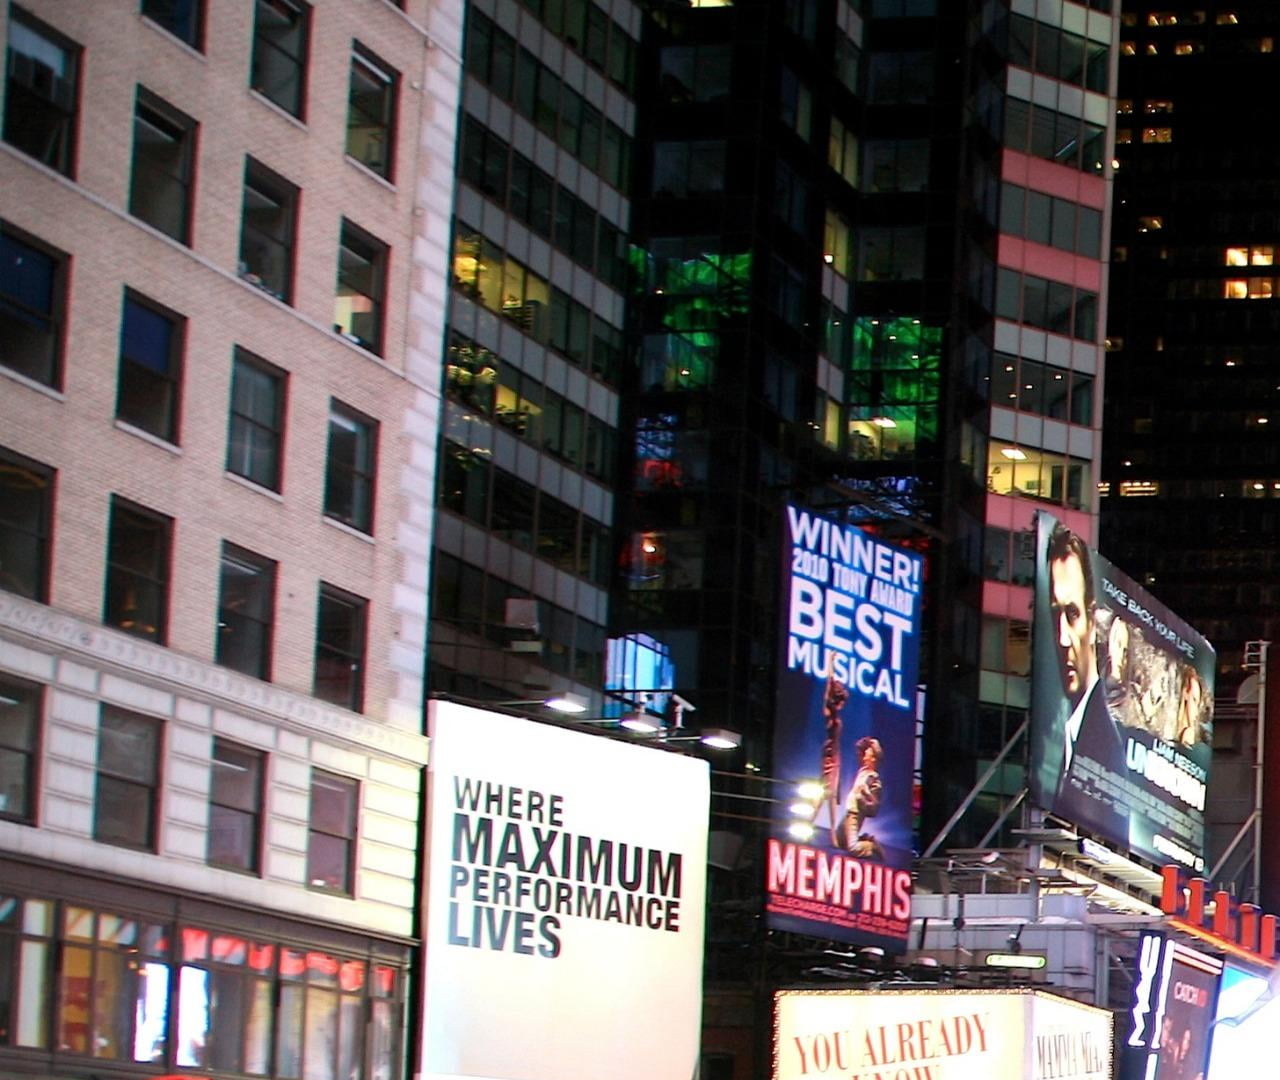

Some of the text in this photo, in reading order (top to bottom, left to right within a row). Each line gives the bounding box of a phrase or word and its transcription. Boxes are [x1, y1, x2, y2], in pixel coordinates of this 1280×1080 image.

[787, 506, 920, 592] WINNER!
[792, 548, 829, 582] 2010
[789, 575, 913, 671] BEST
[1102, 577, 1127, 606] TAKE
[1127, 599, 1154, 627] BACK
[788, 636, 909, 707] MUSICAL
[454, 776, 564, 827] WHERE
[453, 812, 682, 899] MAXIMUM
[767, 838, 911, 919] MEMPHIS
[448, 901, 561, 958] LIVES
[450, 865, 679, 932] PERFORMANCE
[794, 1013, 990, 1075] YOU ALREADY
